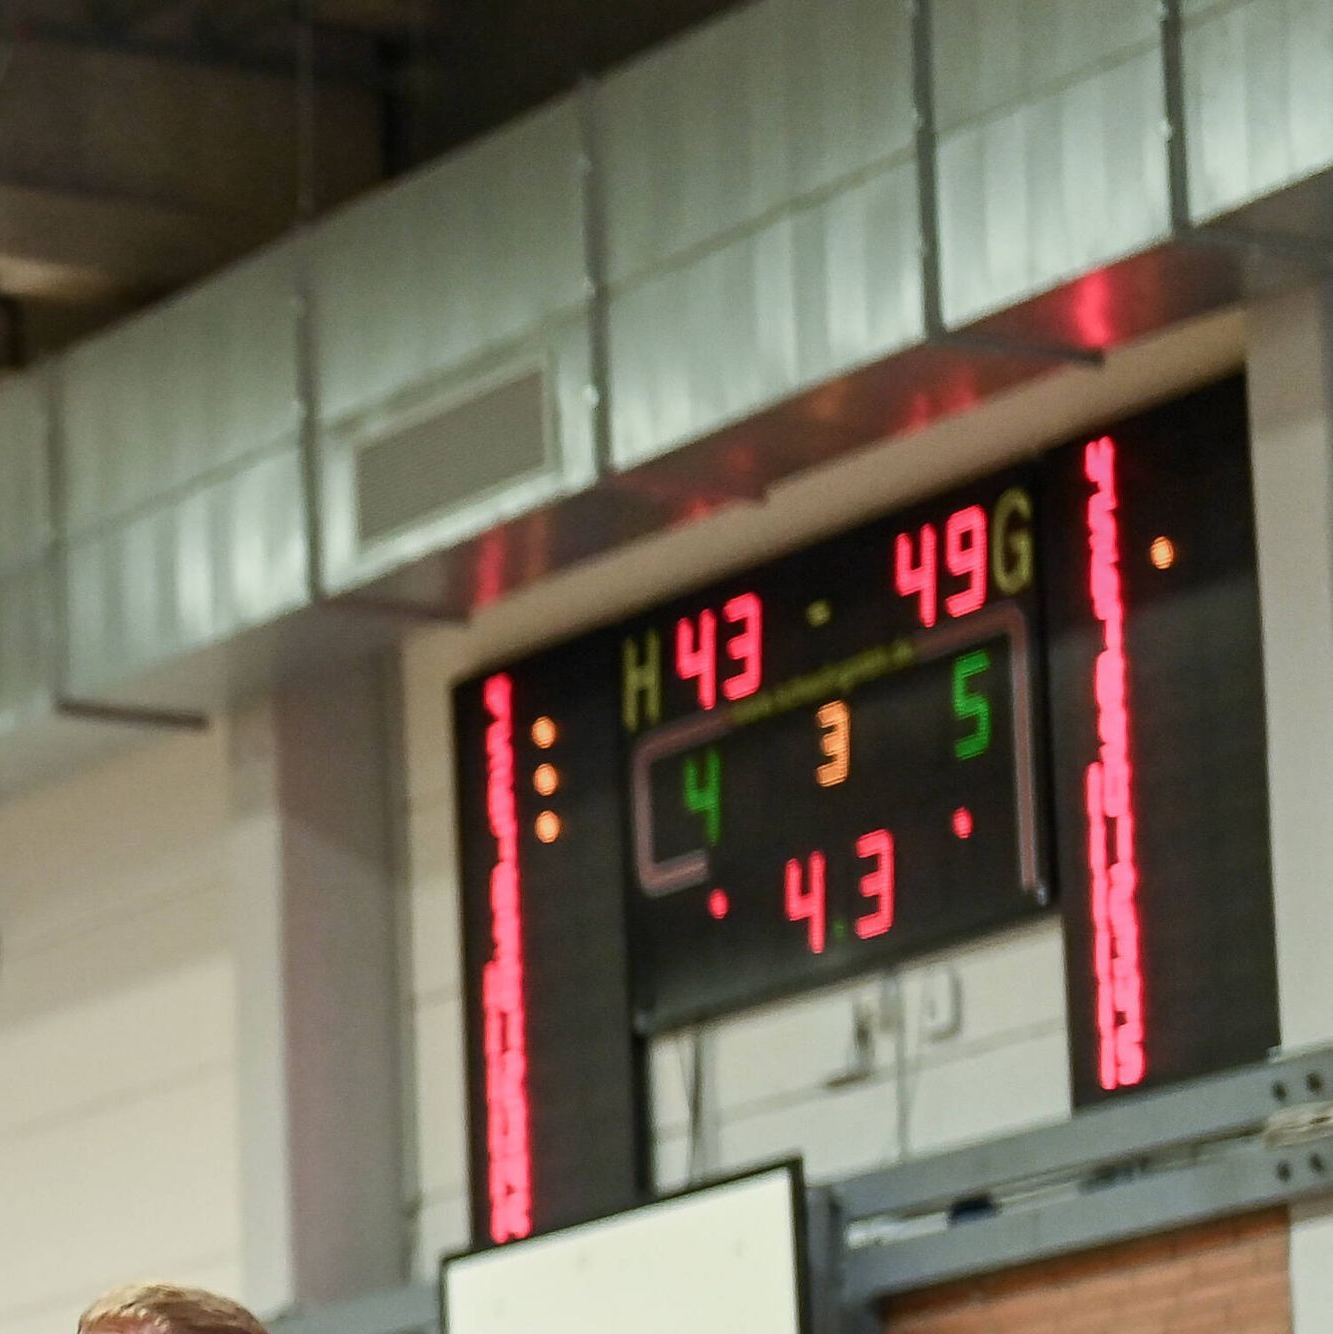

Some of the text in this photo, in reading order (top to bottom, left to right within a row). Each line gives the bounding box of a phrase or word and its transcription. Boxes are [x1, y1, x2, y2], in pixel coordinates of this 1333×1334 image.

[675, 591, 763, 710] 43
[894, 504, 988, 628] 49
[991, 488, 1032, 595] G
[684, 748, 721, 846] 4
[816, 700, 851, 787] 3
[952, 650, 991, 760] 5
